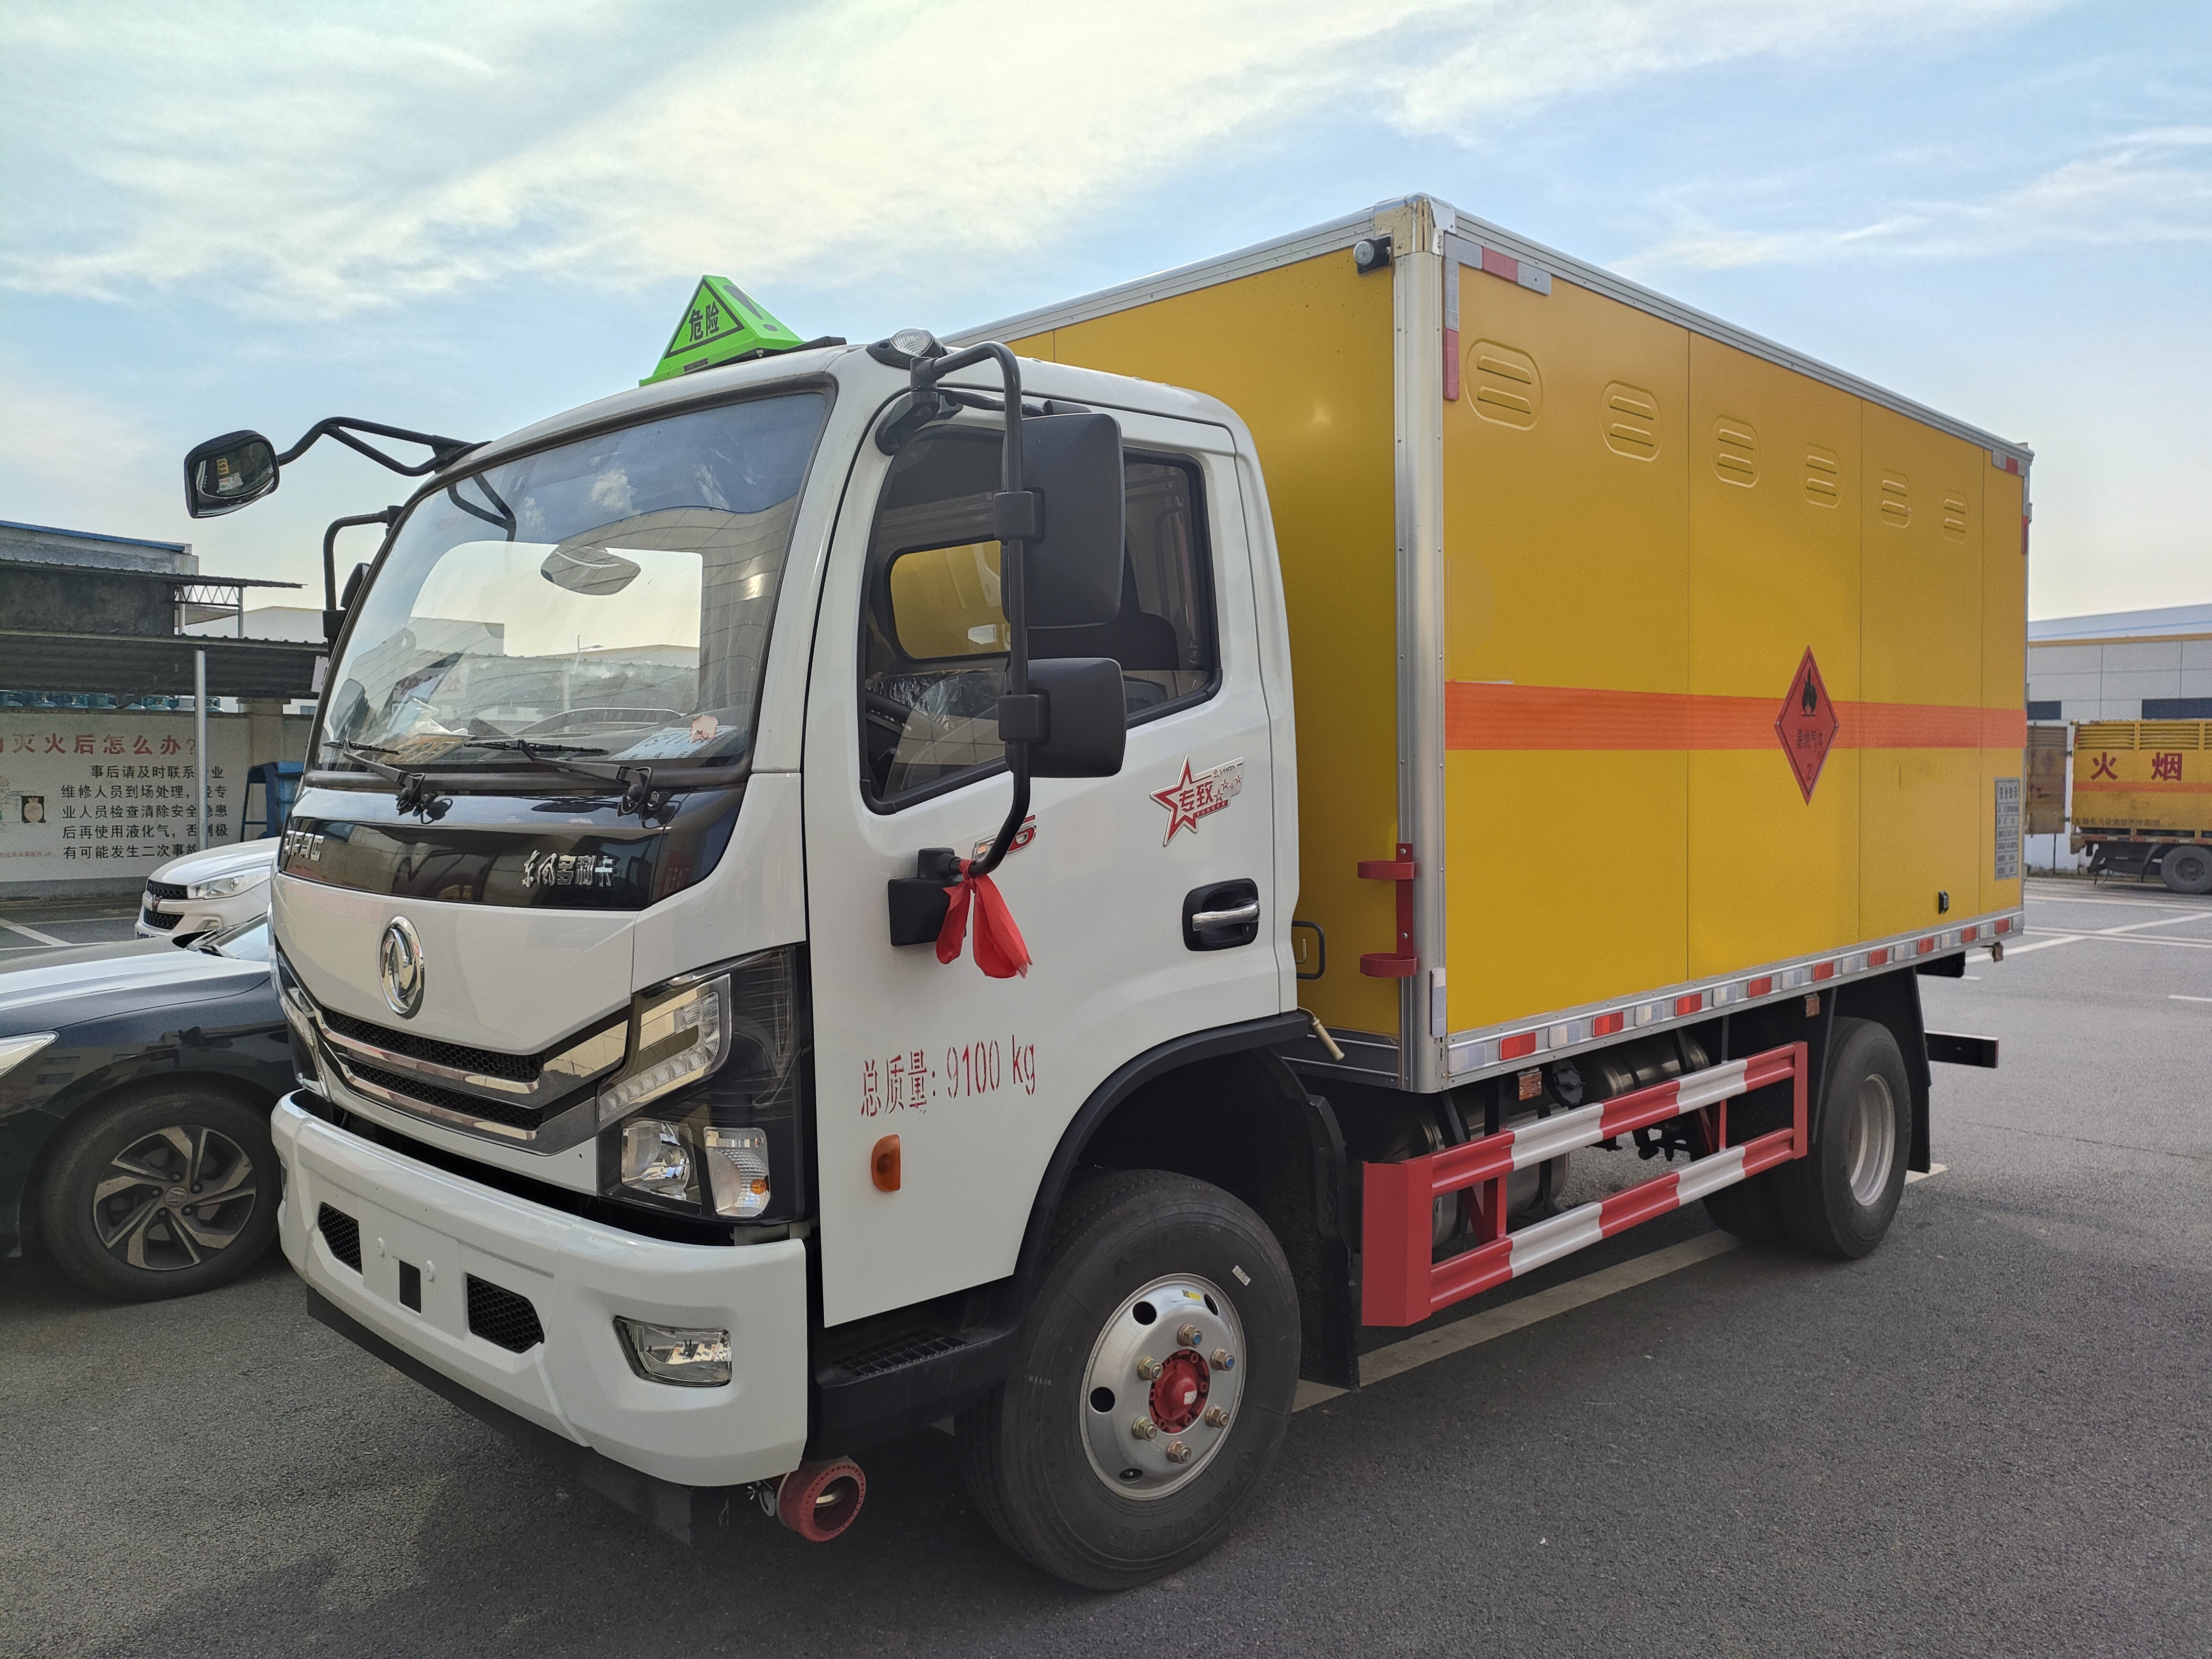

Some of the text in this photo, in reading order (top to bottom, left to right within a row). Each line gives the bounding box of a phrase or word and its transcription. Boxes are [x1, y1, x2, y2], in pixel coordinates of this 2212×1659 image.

[689, 301, 719, 342] 危险
[0, 733, 196, 756] 灭火后怎么办？
[90, 765, 224, 779] 事后请及时联系业
[1179, 780, 1213, 812] 专致
[521, 850, 616, 888] 东风多利卡
[947, 1039, 1000, 1099] 9100
[1012, 1034, 1036, 1096] kg
